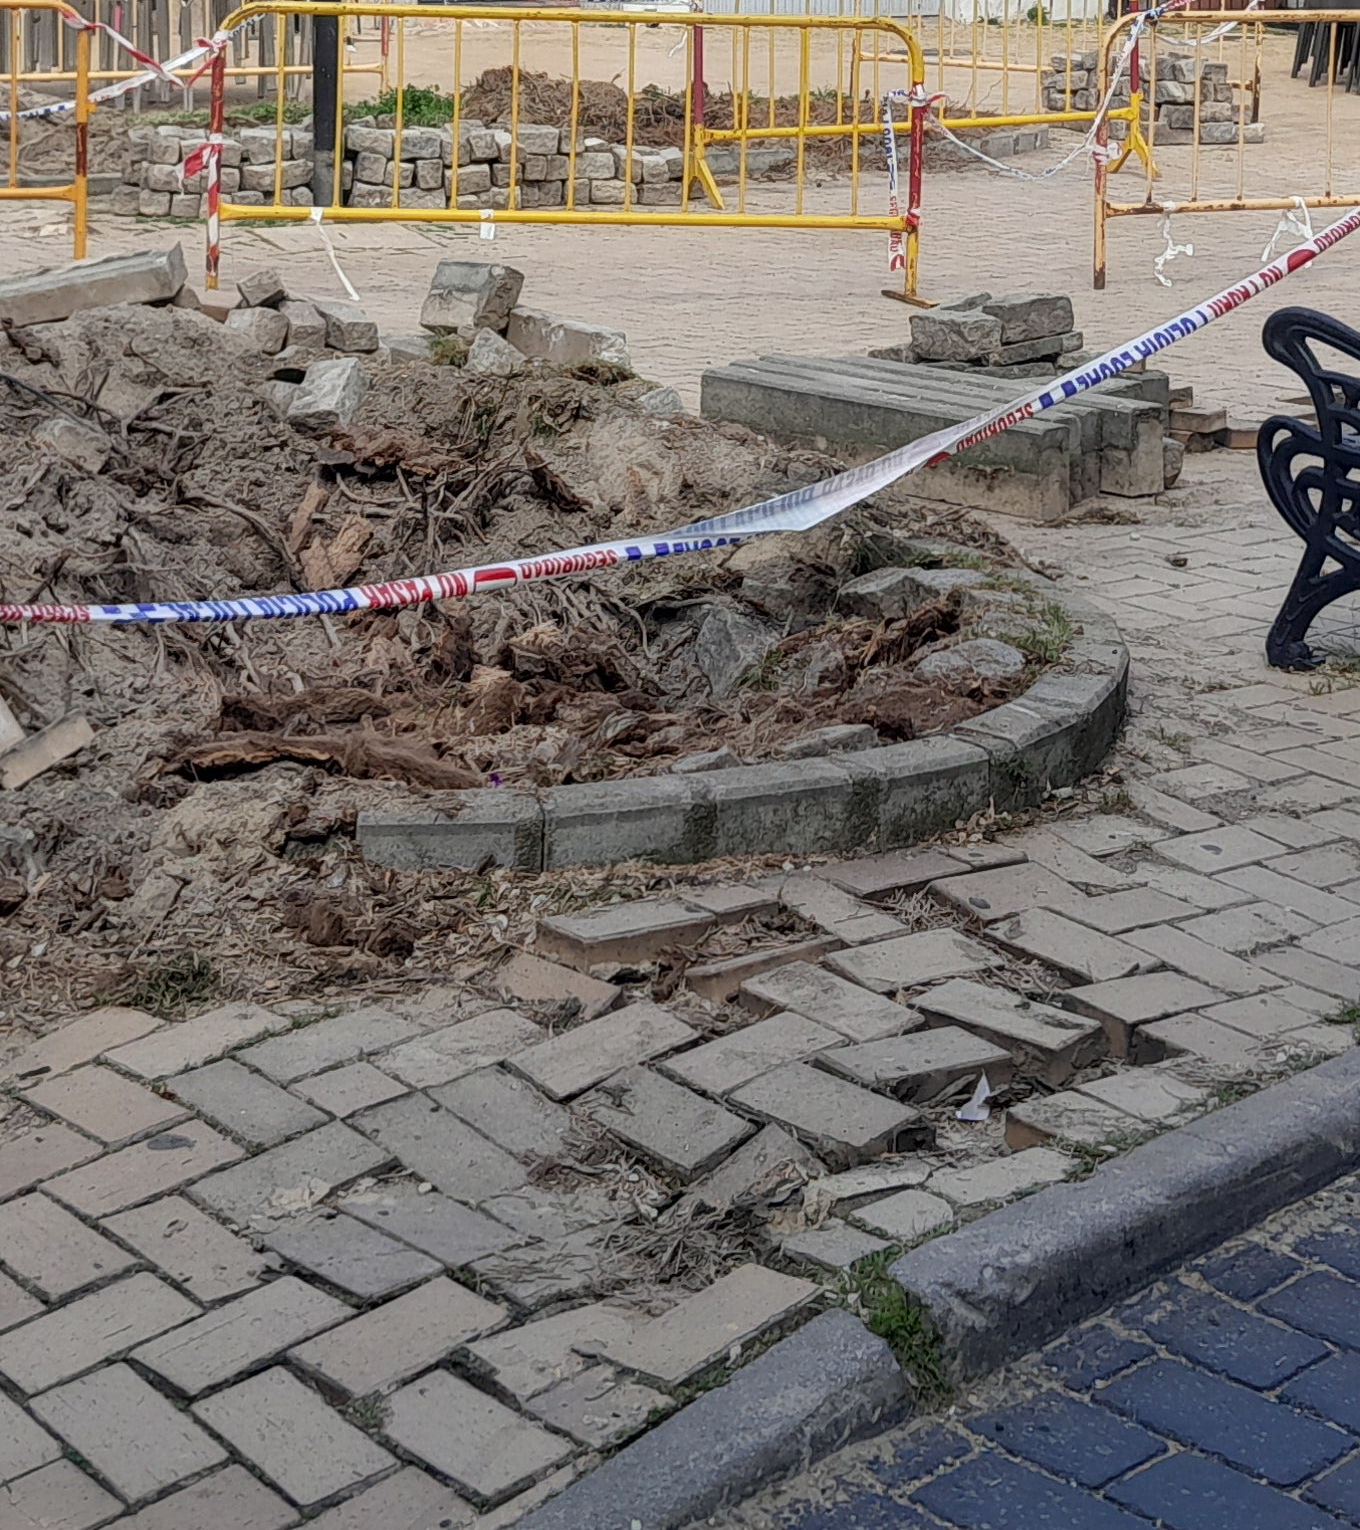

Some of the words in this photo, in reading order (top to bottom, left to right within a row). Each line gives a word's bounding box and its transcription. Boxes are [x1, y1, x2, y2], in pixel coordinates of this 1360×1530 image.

[521, 548, 620, 580] SEGURIDAD
[359, 577, 434, 609] PASAR
[441, 571, 469, 599] NO
